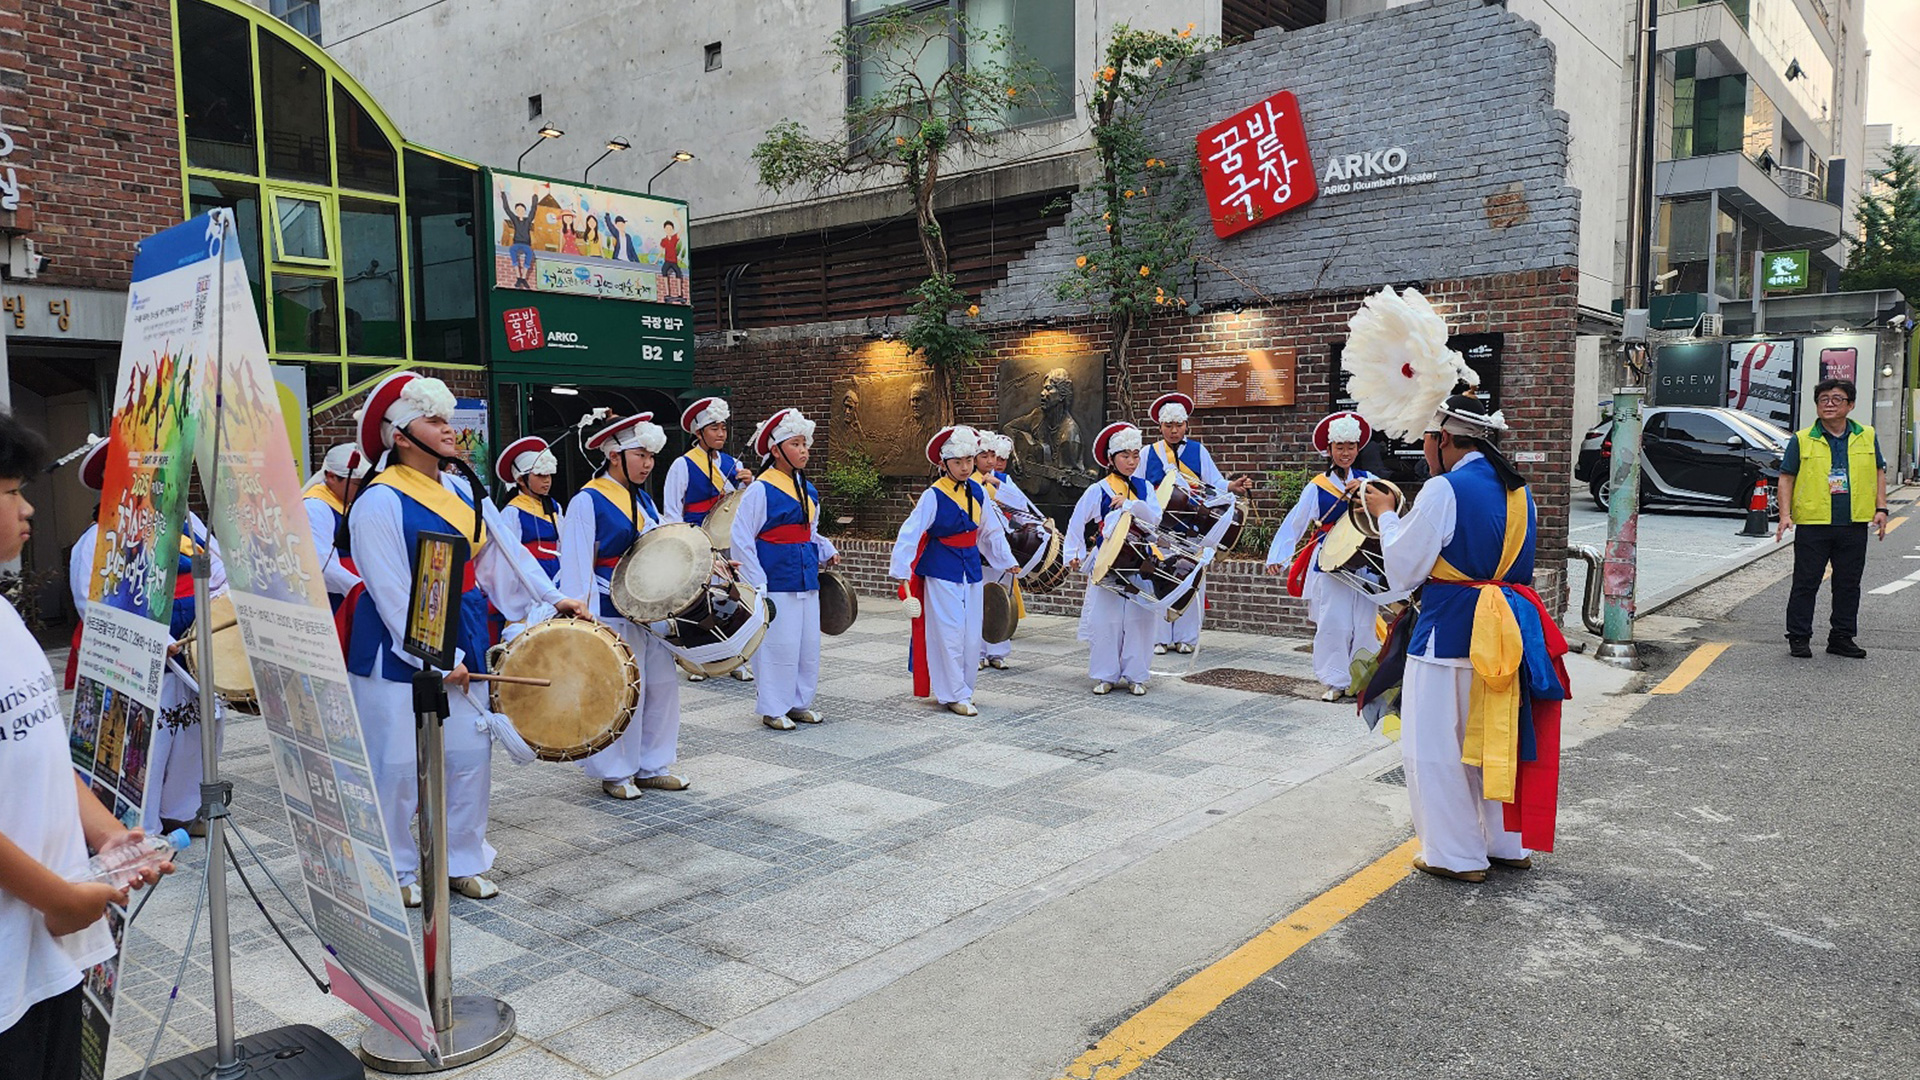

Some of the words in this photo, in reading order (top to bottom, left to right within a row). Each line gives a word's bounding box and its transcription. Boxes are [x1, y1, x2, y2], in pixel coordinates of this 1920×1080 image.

[1323, 147, 1408, 183] ARKO
[1323, 183, 1351, 196] ARKO
[1353, 176, 1396, 192] Kkumbat
[1398, 171, 1438, 185] Theater
[641, 315, 662, 329] 극장
[663, 317, 684, 331] 입구
[547, 331, 578, 342] ARKO
[642, 344, 663, 361] B2
[1661, 374, 1715, 386] GREW
[131, 472, 150, 497] 2025
